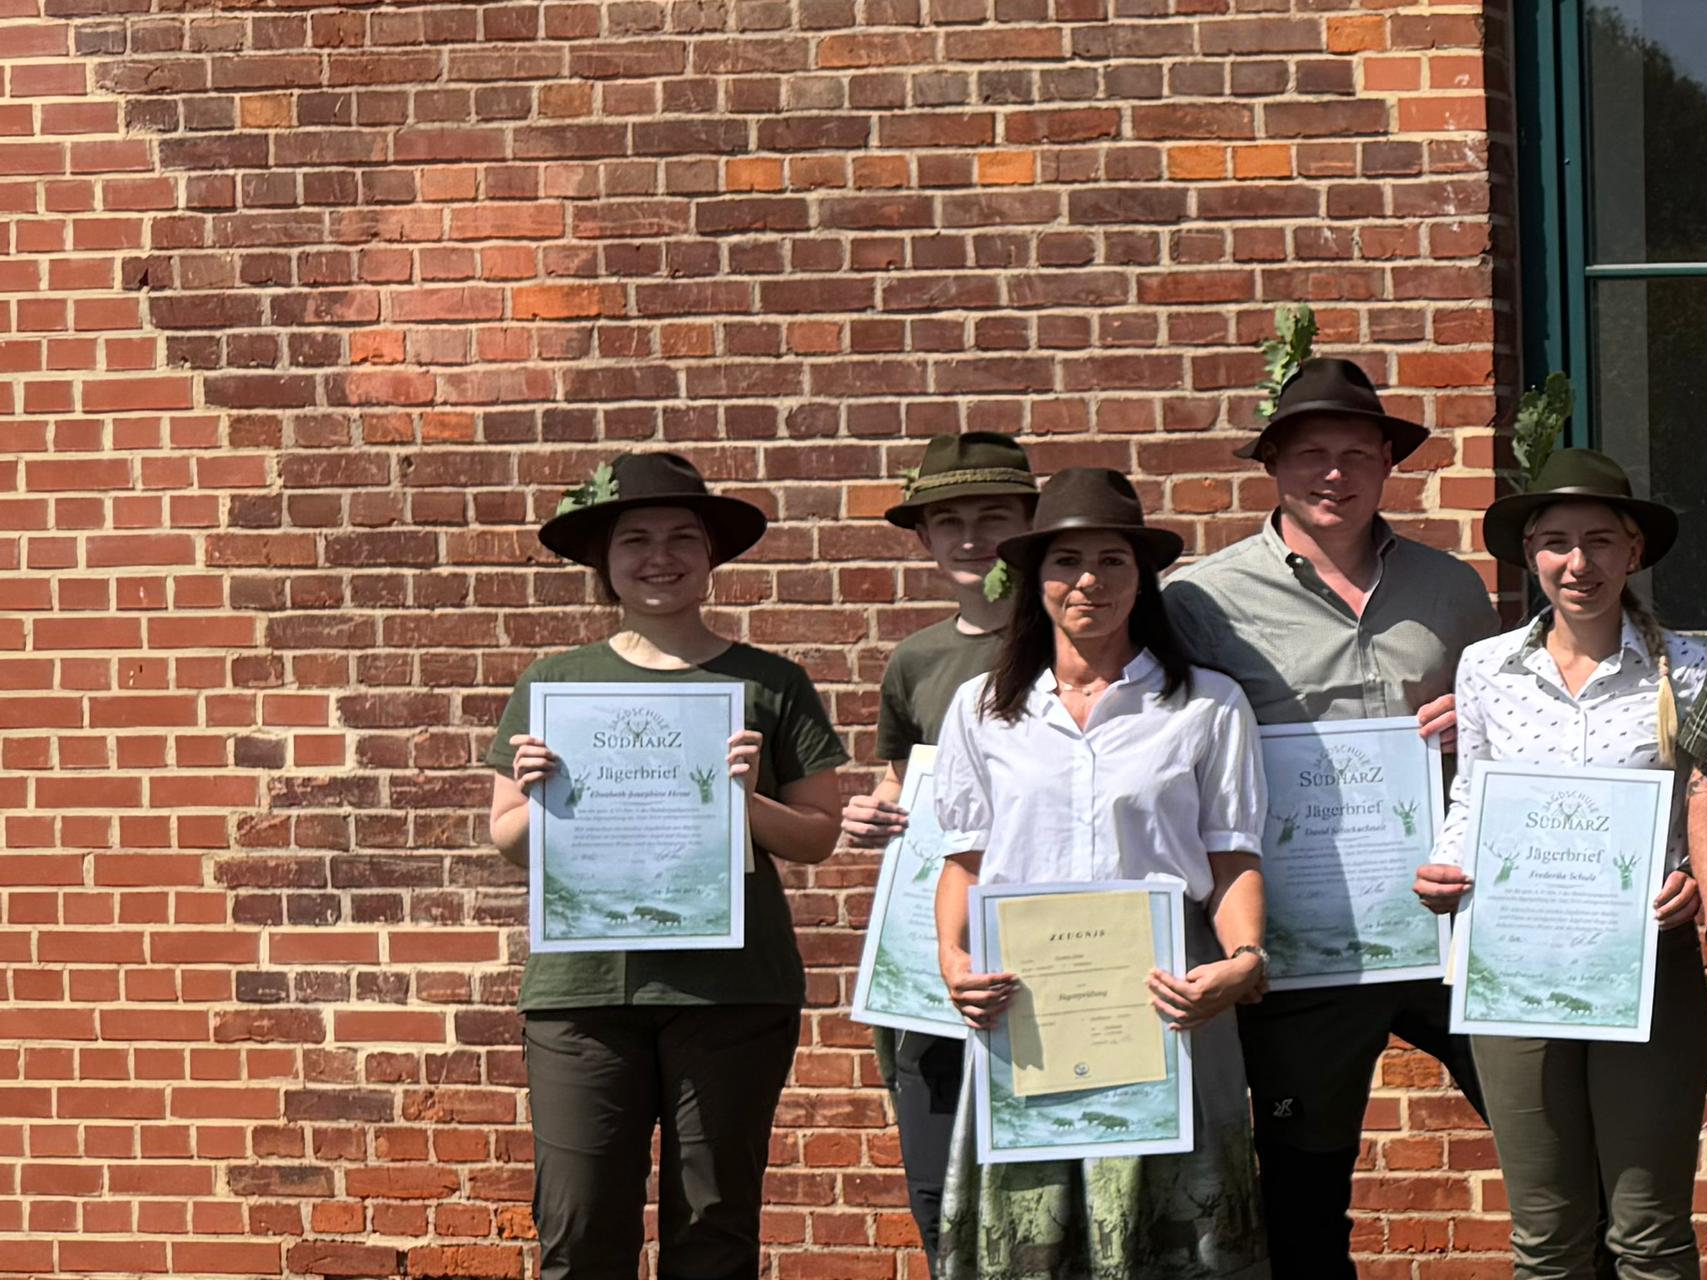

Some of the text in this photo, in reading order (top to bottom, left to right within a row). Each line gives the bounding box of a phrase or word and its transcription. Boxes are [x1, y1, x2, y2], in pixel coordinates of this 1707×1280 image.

[593, 731, 682, 749] SÜDHARZ
[597, 765, 680, 784] Jägerbrief
[1300, 766, 1384, 788] SÜDHARZ
[1305, 800, 1384, 820] Jägerbrief
[1525, 811, 1610, 832] SÜDHARZ
[1526, 846, 1605, 864] Jägerbrief
